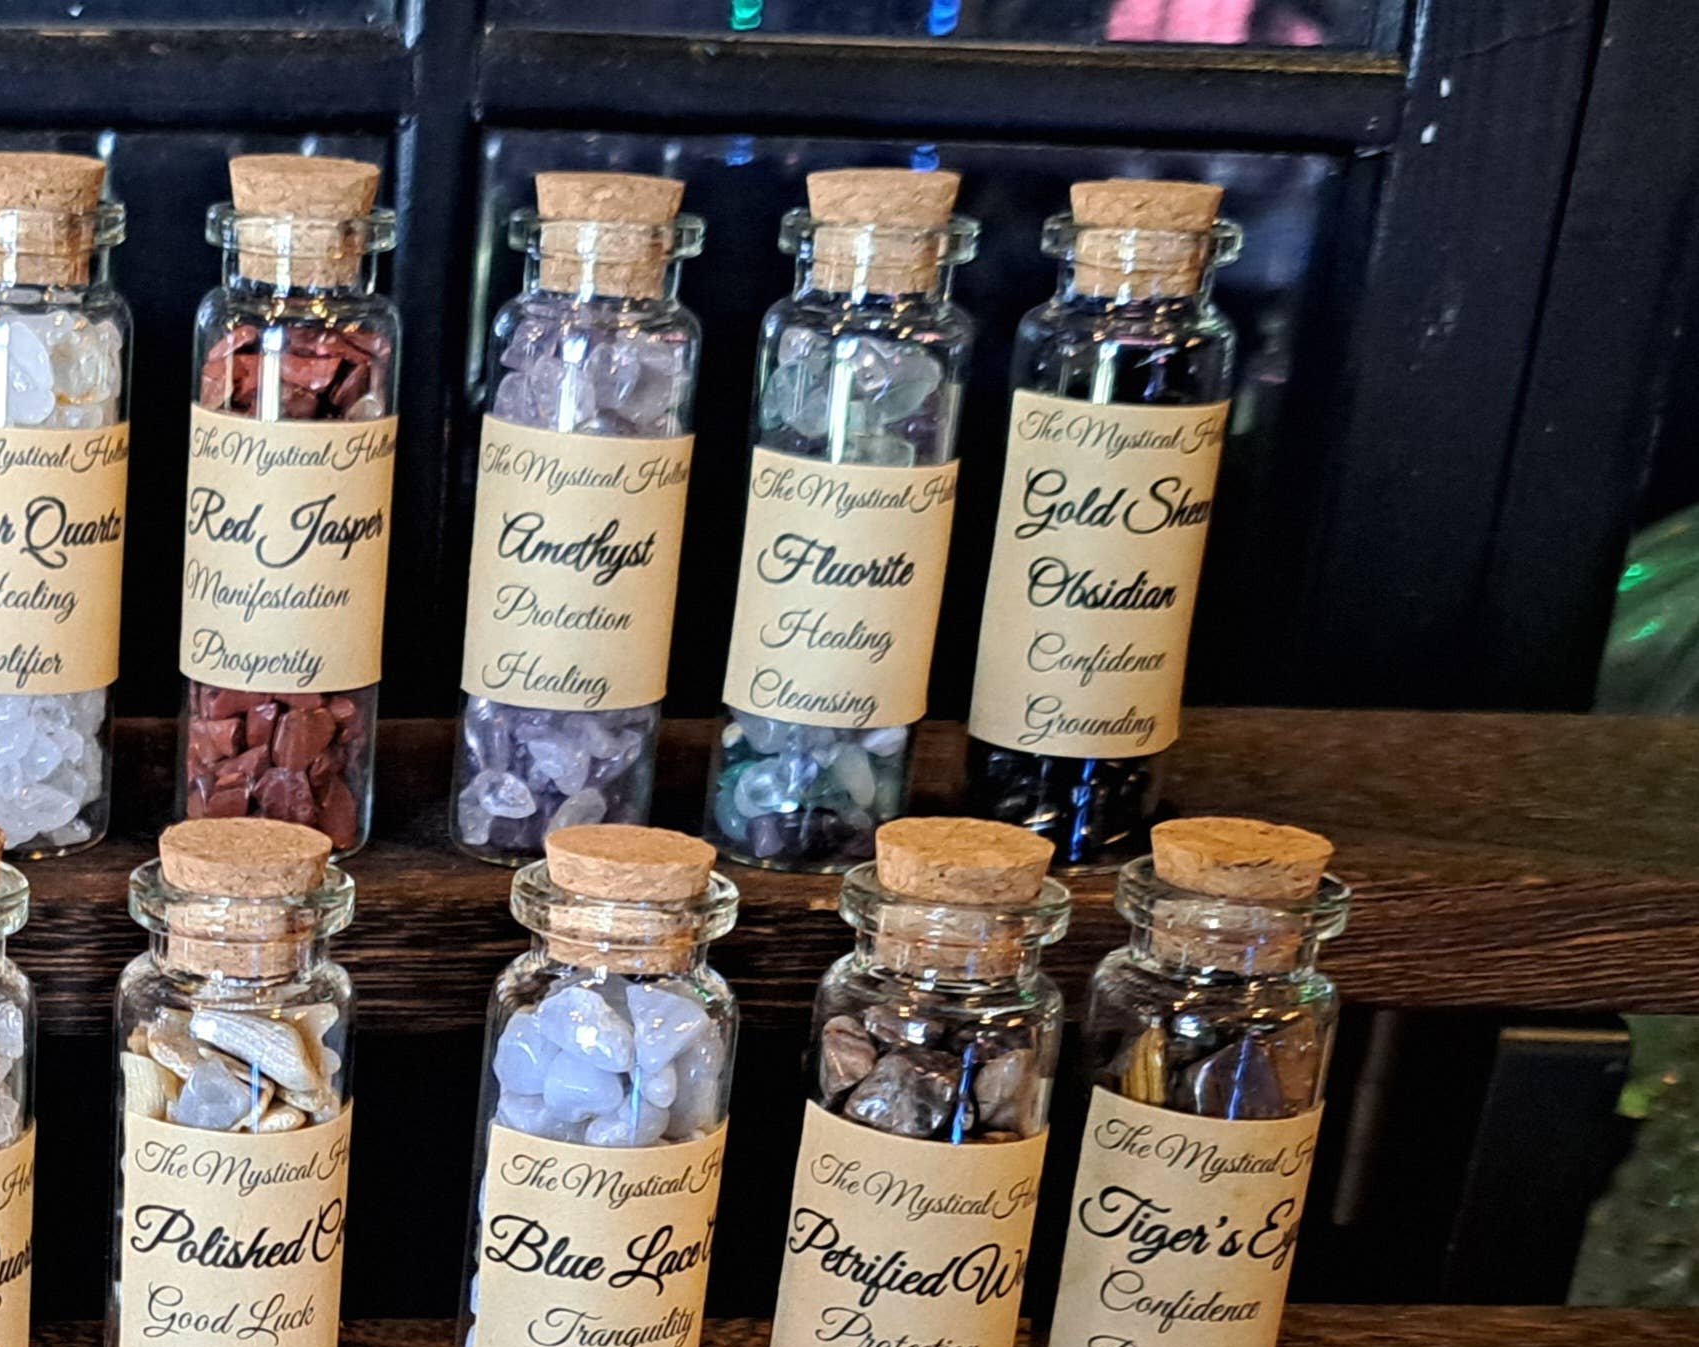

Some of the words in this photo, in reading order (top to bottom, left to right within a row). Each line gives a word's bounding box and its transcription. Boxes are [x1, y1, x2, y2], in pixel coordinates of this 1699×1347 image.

[220, 432, 330, 476] Mystical
[1018, 410, 1065, 443] The
[1066, 416, 1182, 459] Mystical
[513, 454, 623, 496] Mystical
[752, 467, 795, 501] The
[797, 474, 911, 519] Mystical
[1015, 466, 1118, 539] Gold
[19, 496, 122, 569] Quartz
[188, 487, 256, 542] Red
[255, 494, 384, 568] Jasper
[498, 511, 656, 586] Amethyst
[757, 533, 915, 589] Fluorite
[1027, 556, 1177, 610] Obsidian
[186, 561, 351, 622] Manifestation
[493, 585, 633, 631] Protection
[191, 629, 325, 686] Prosperity
[760, 609, 895, 663] Healing
[1027, 631, 1166, 686] Confidence
[482, 651, 611, 708] Healing
[750, 665, 879, 727] Cleansing
[1017, 693, 1157, 746] Grounding
[135, 1140, 188, 1179] The
[189, 1152, 318, 1194] Mystical
[1094, 1118, 1154, 1159] The
[1155, 1133, 1286, 1183] Mystical
[500, 1153, 559, 1193] The
[562, 1162, 691, 1210] Mystical
[810, 1153, 861, 1194] The
[863, 1169, 995, 1222] Mystical
[130, 1203, 307, 1271] Polished
[1078, 1185, 1245, 1265] Tiger's
[485, 1213, 606, 1281] Blue
[609, 1225, 702, 1297] Lace
[789, 1208, 959, 1307] Petrified
[143, 1281, 234, 1338] Good
[236, 1286, 316, 1346] Luck
[1100, 1264, 1261, 1334] Confidence
